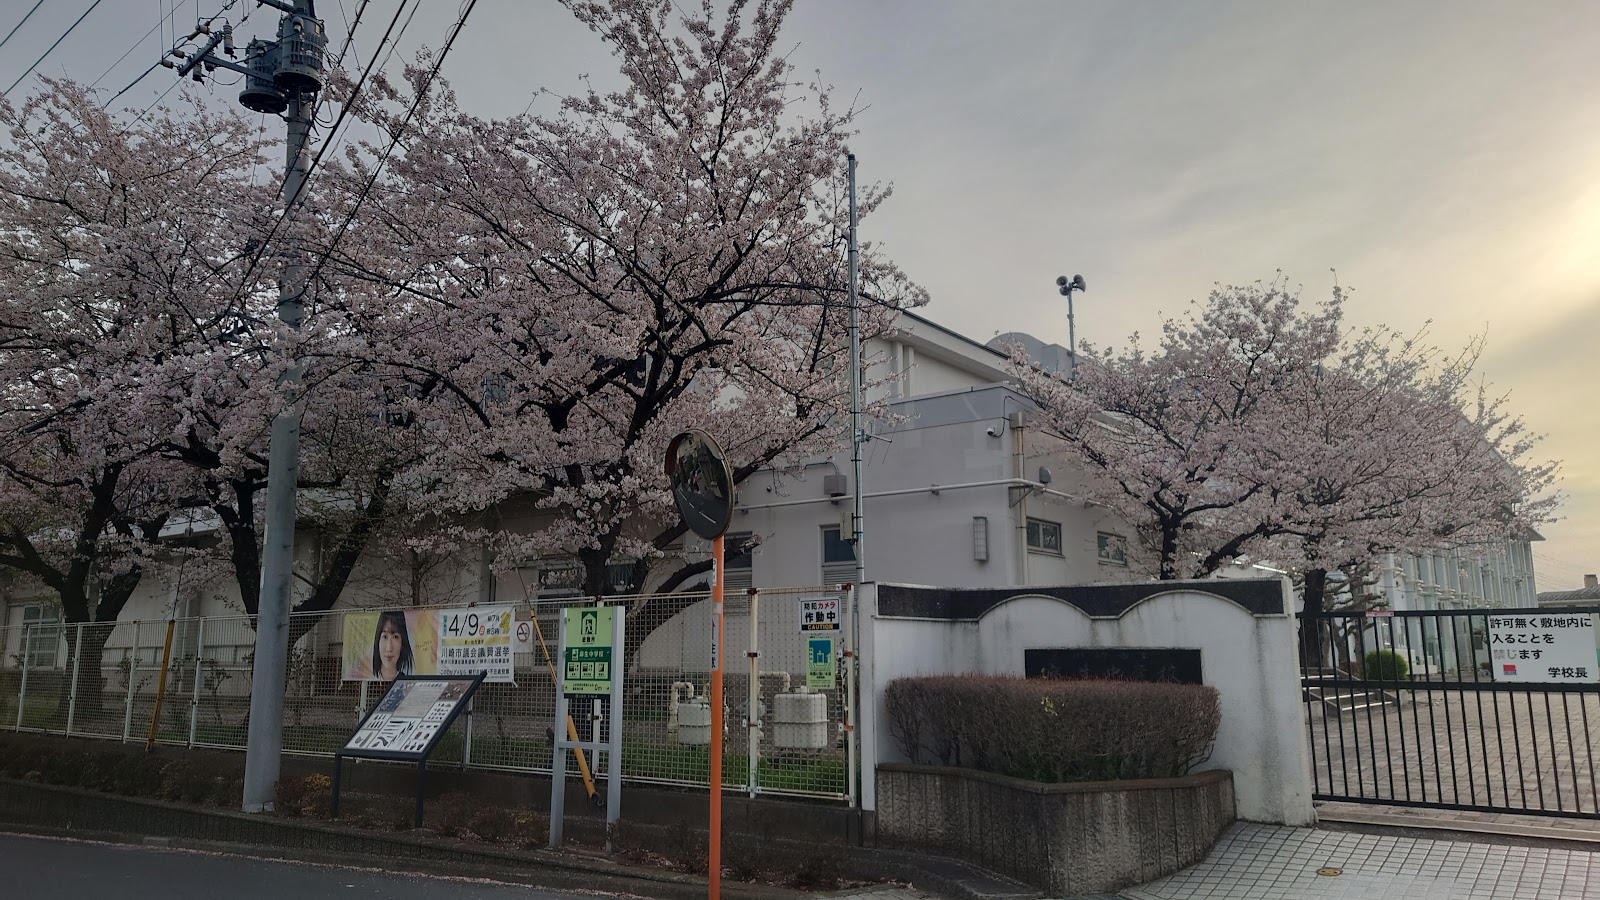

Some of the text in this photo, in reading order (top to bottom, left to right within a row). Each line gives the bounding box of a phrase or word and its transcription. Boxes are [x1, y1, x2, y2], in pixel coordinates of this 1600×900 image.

[804, 602, 836, 610] 防犯カメラ
[805, 611, 836, 623] 作動中
[1489, 617, 1592, 628] 許可無く敷地内に
[448, 613, 479, 636] 4/9
[1492, 633, 1554, 644] 入ることを
[441, 646, 510, 658] 川崎市議会議員選挙
[1493, 649, 1543, 660] 禁じます
[1548, 667, 1588, 678] 学校長
